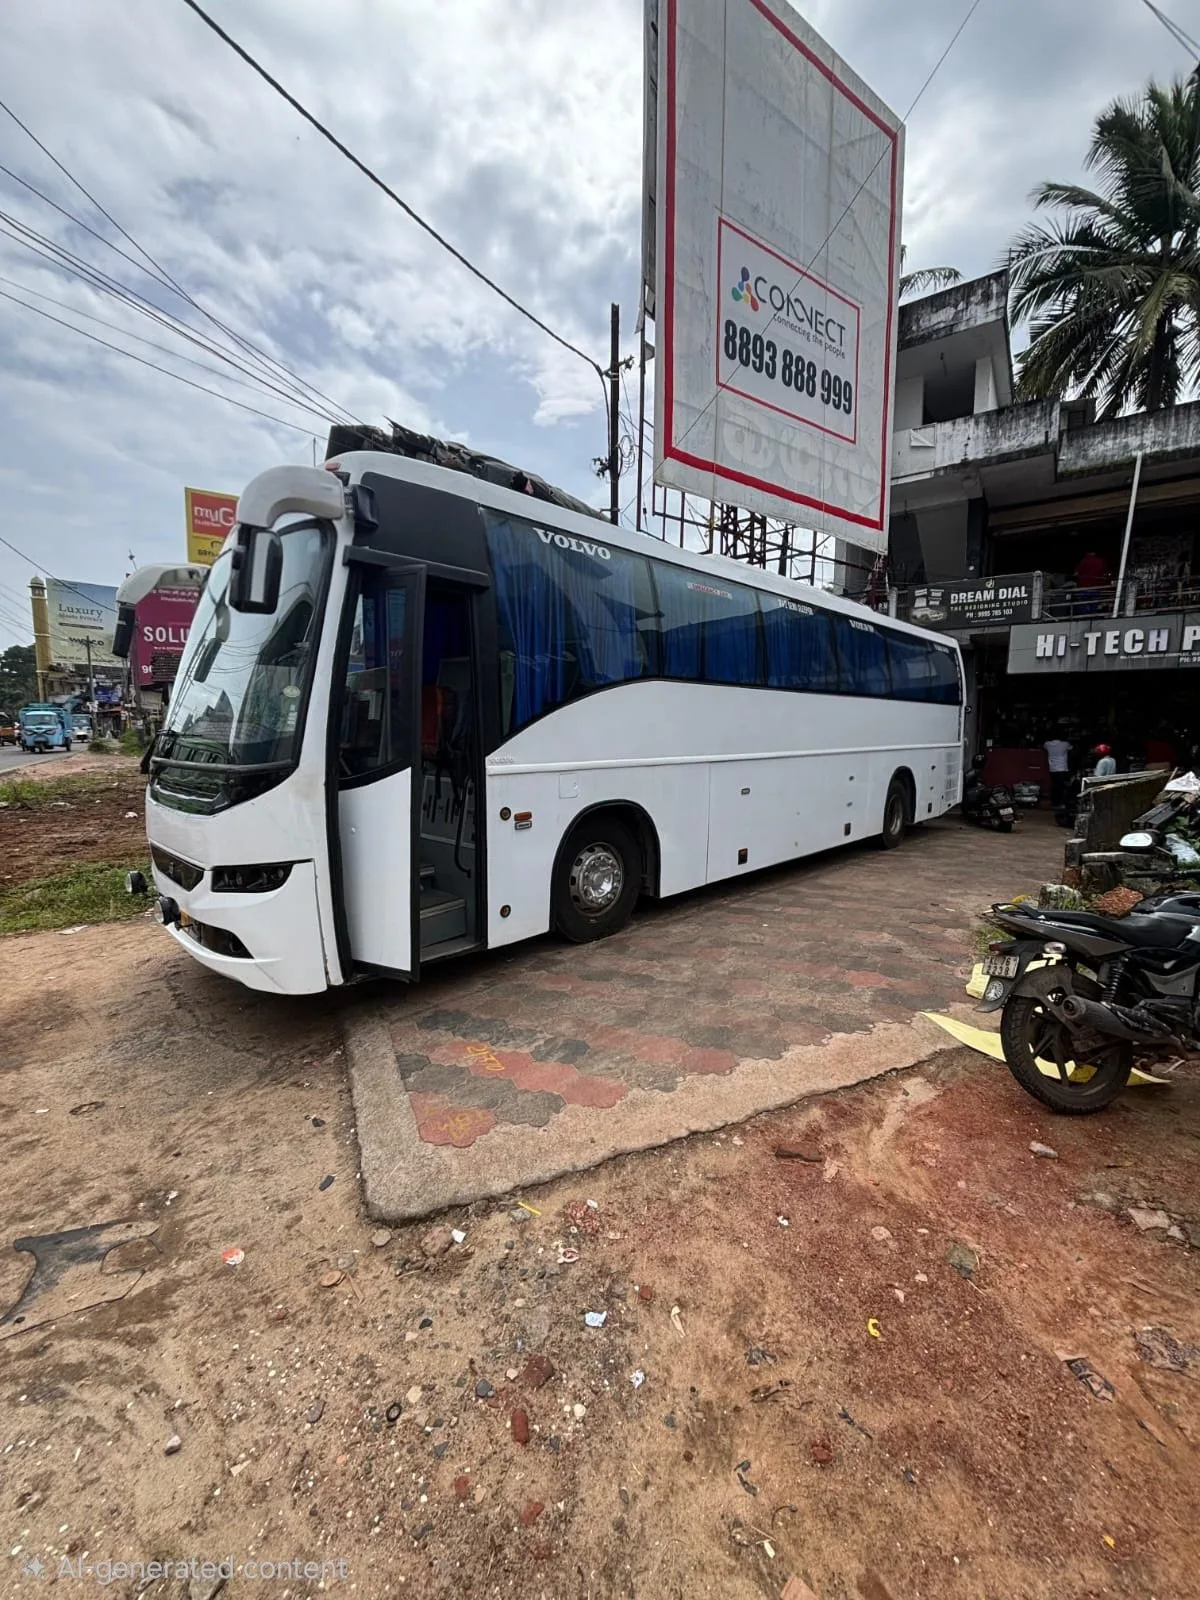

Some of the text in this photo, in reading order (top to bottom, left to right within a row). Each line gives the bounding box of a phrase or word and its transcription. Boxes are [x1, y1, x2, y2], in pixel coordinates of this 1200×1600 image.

[754, 276, 846, 347] CONNECT
[773, 313, 811, 343] connecting
[724, 320, 853, 415] 8893 888 999
[194, 506, 235, 526] myG
[532, 527, 611, 560] VOLVO
[58, 603, 103, 617] Luxury
[950, 589, 995, 604] DREAM
[999, 586, 1028, 599] DIAL
[1036, 625, 1200, 657] HI-TECH P
